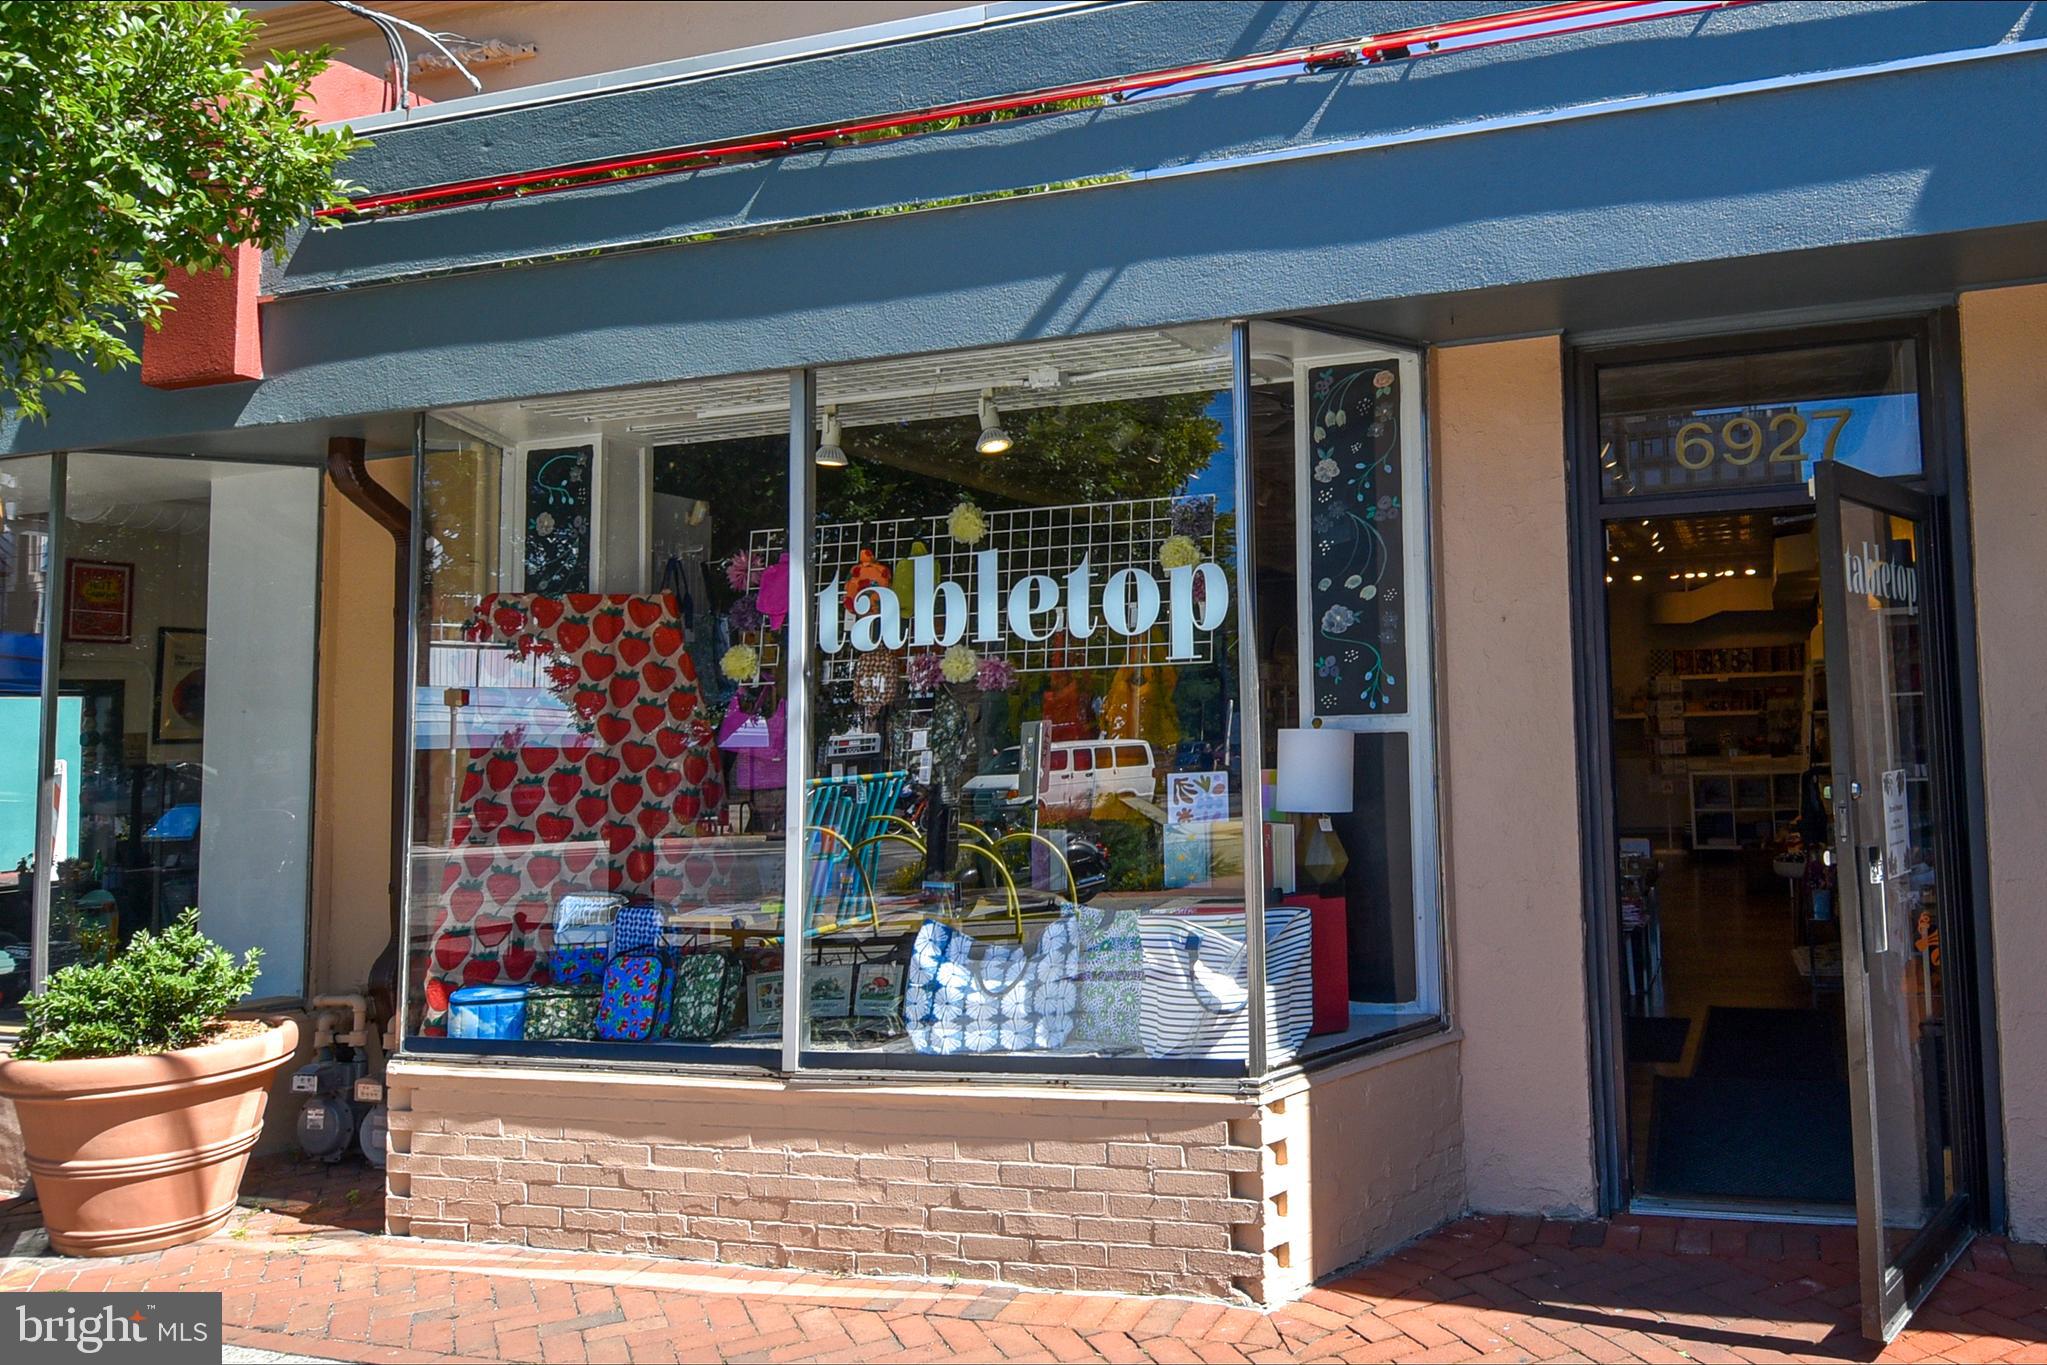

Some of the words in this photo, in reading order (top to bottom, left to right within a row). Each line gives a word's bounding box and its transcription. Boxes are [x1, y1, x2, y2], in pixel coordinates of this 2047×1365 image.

[1675, 408, 1852, 470] 6927
[815, 548, 1229, 660] tabletop
[1844, 541, 1917, 616] tabletop
